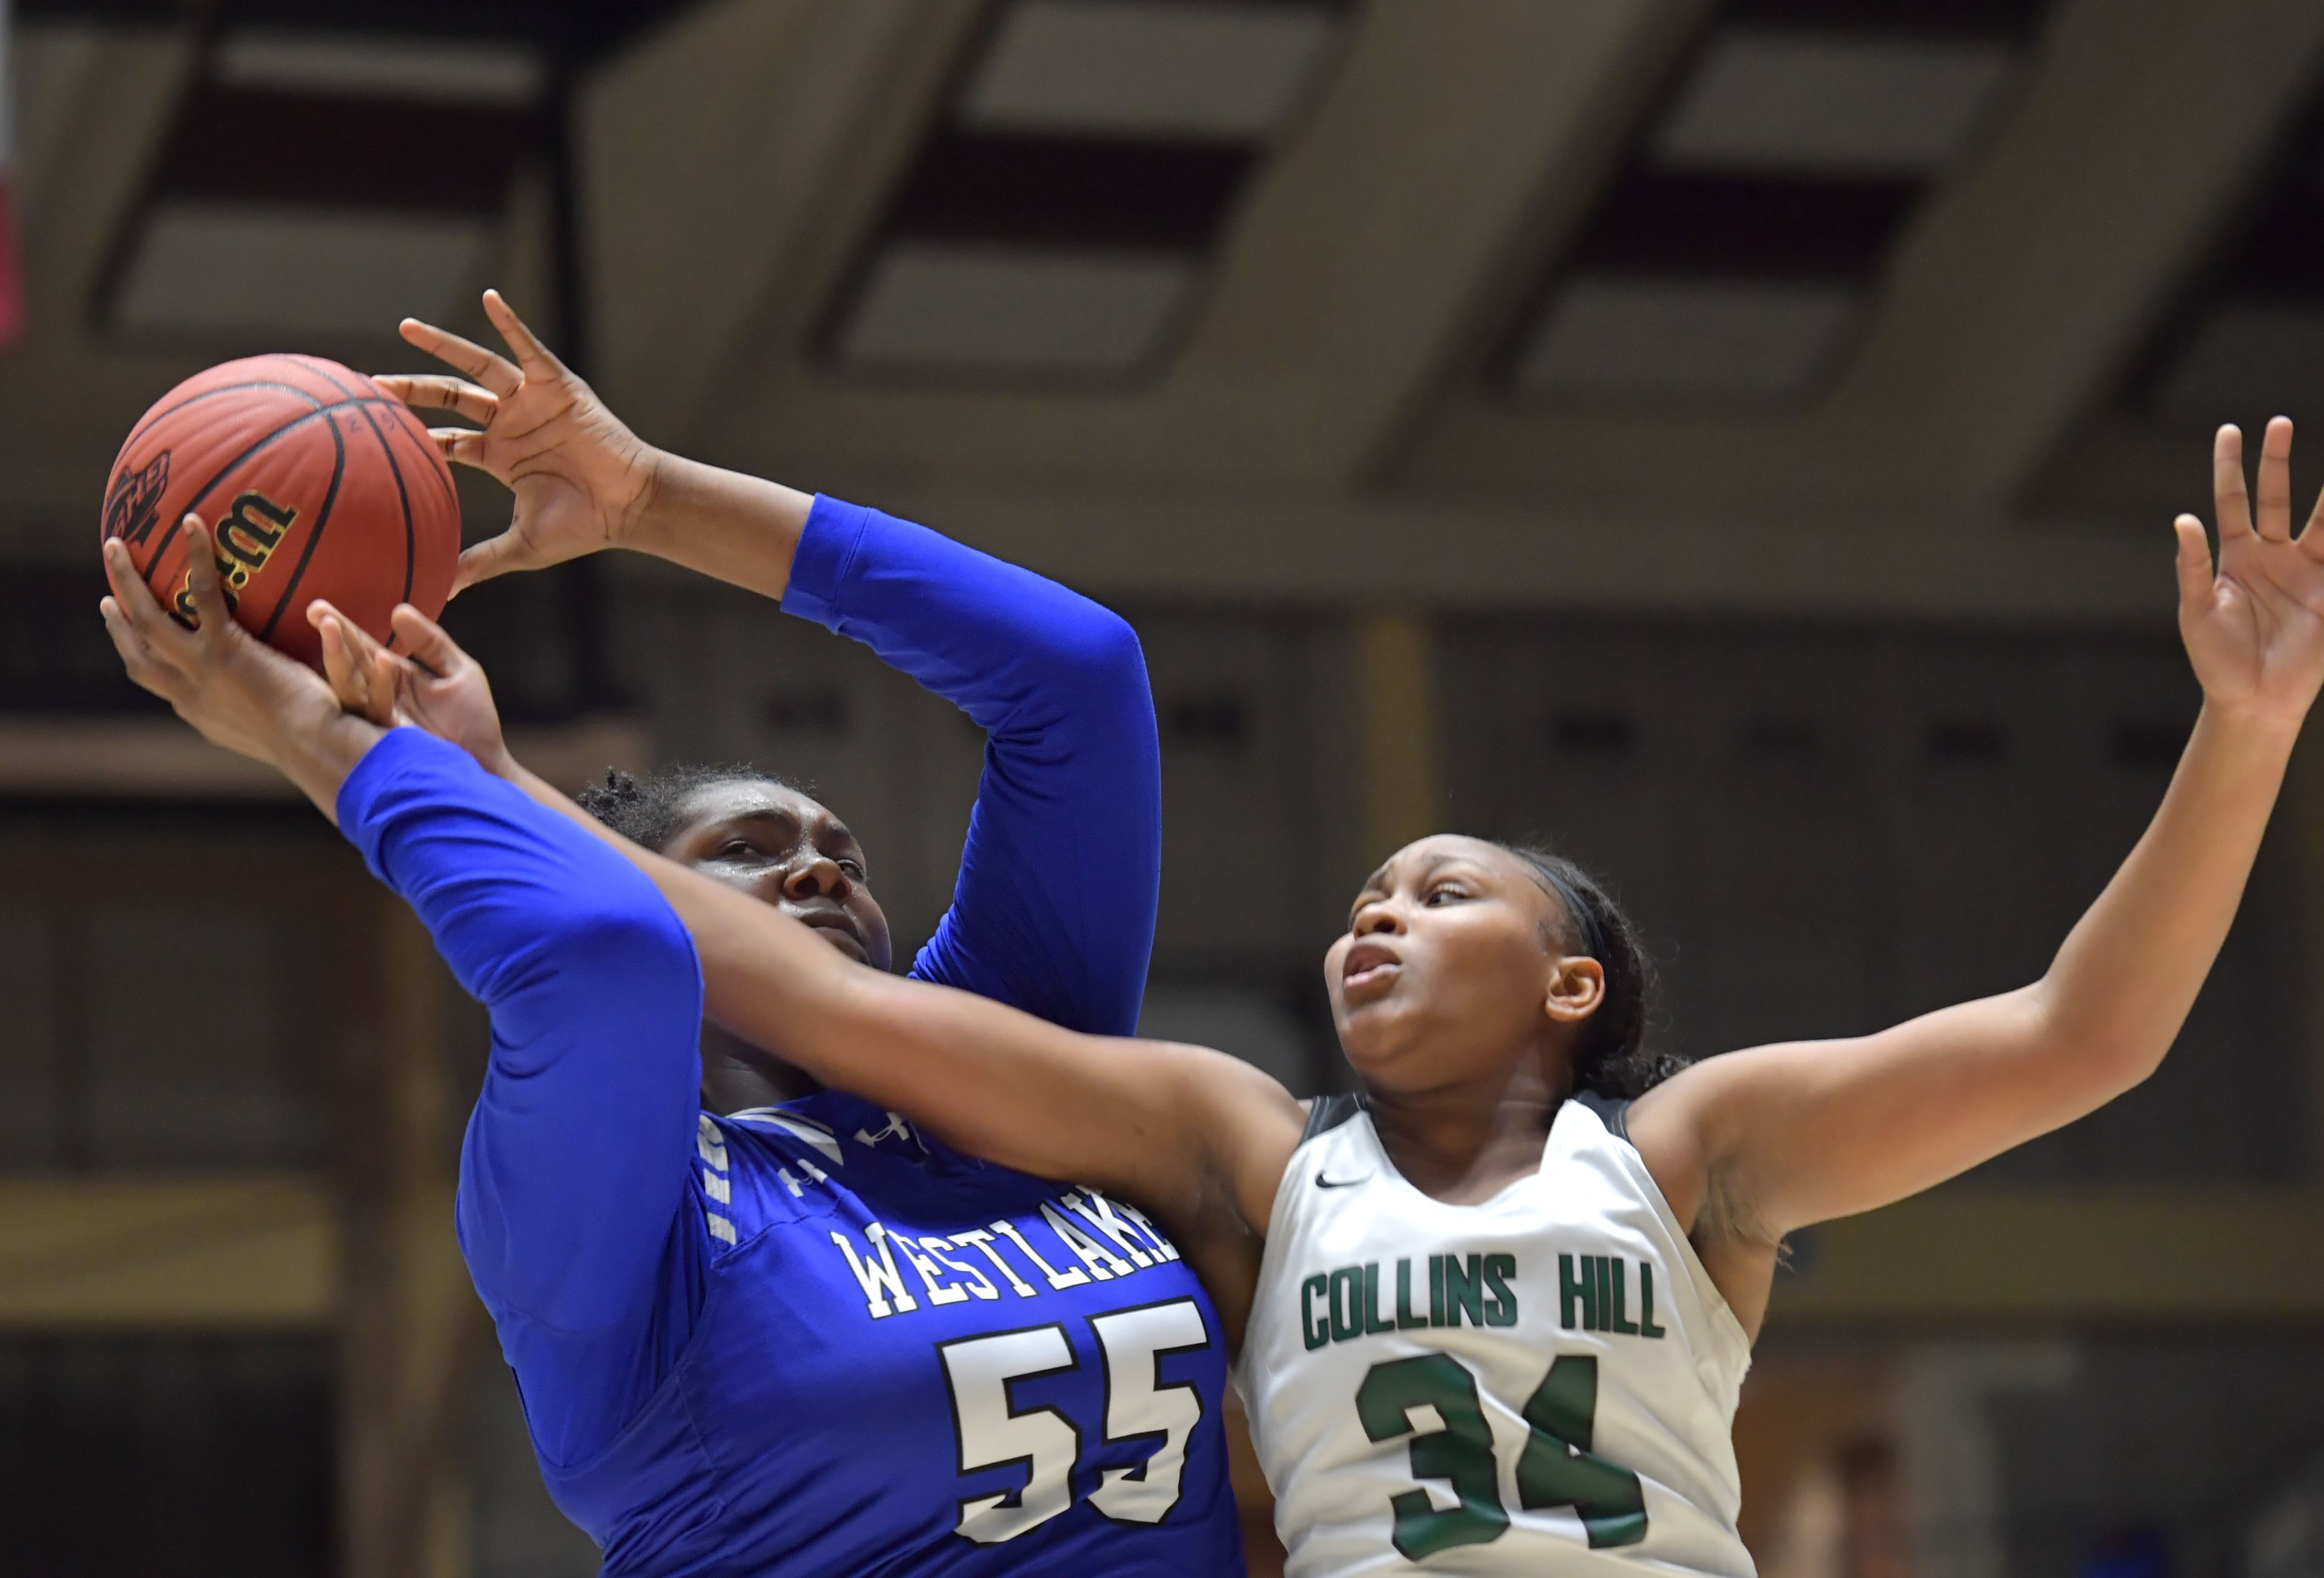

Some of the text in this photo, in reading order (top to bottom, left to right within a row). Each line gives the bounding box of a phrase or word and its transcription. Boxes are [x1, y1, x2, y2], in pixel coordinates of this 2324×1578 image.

[830, 1184, 1181, 1320] WESTLAKE
[1301, 1252, 1666, 1351] COLLINS HILL
[934, 1295, 1210, 1548] 55
[1355, 1353, 1648, 1561] 34
